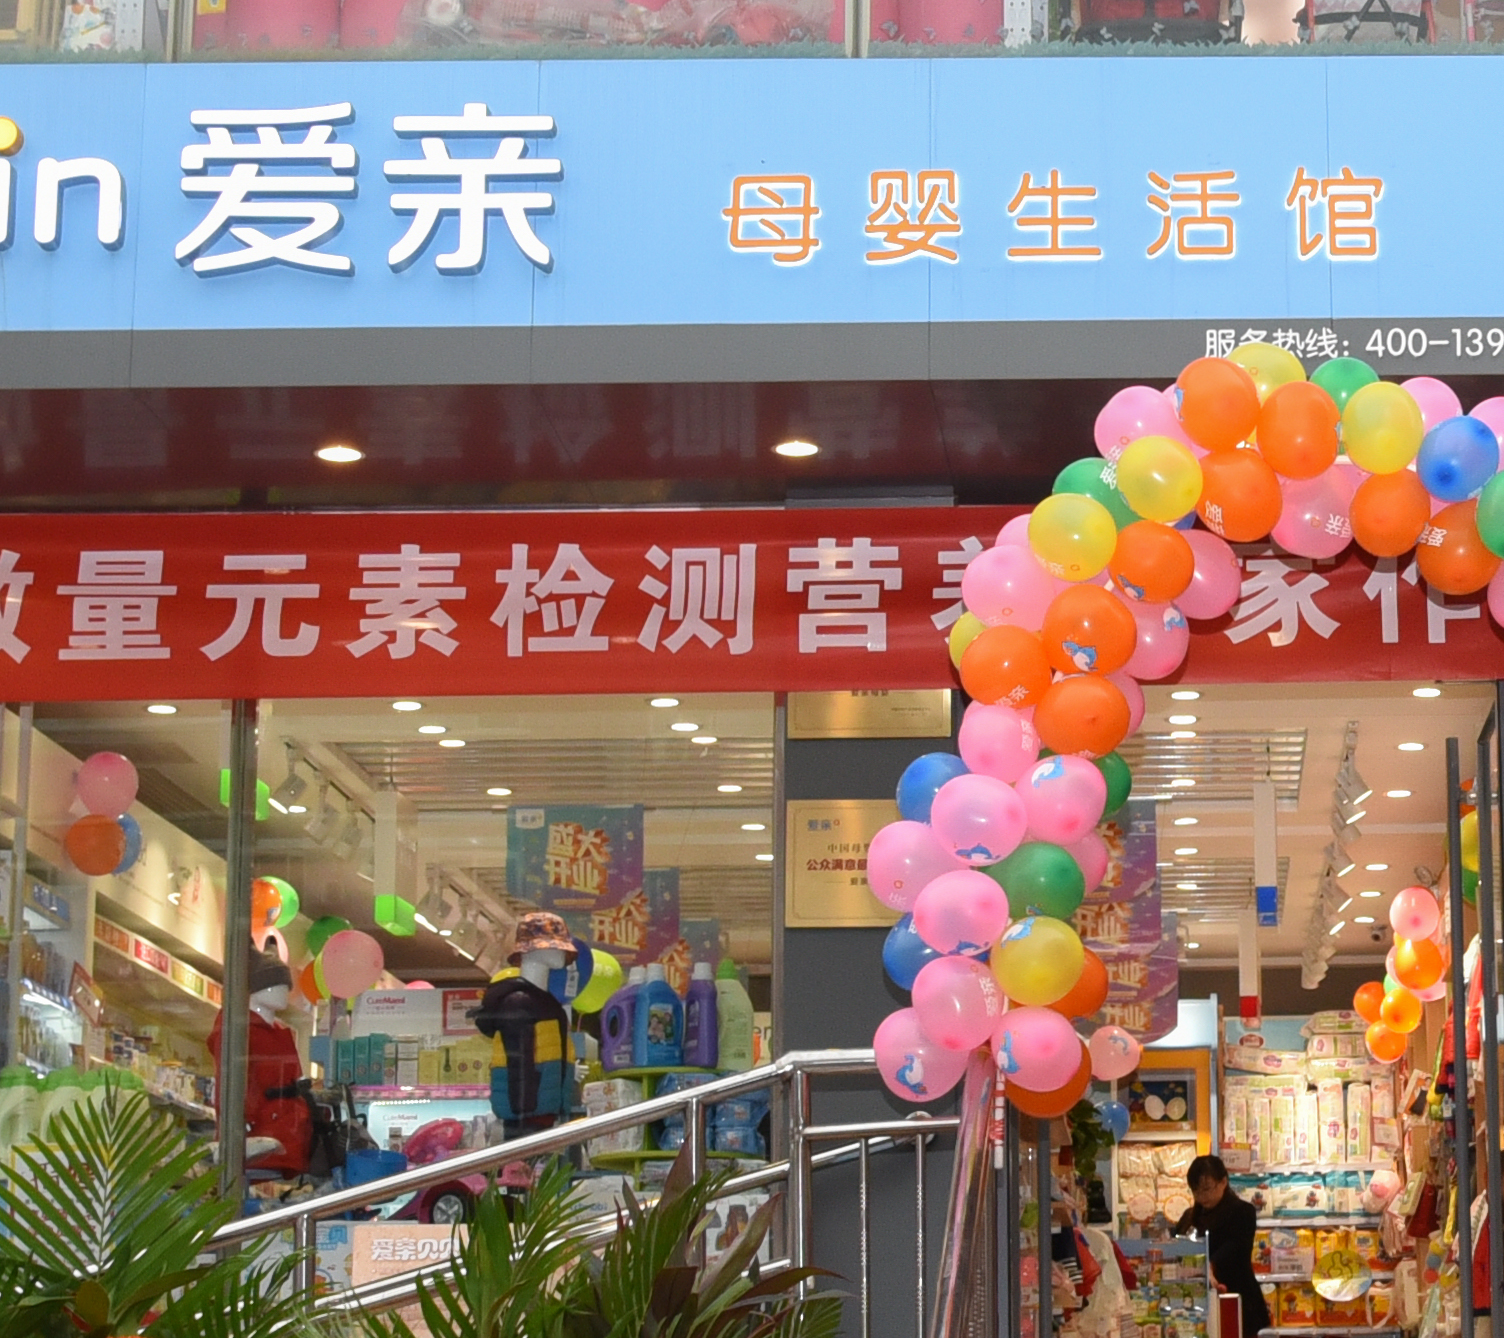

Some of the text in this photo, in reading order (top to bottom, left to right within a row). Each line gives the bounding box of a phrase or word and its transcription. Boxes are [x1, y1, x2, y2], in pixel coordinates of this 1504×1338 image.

[175, 101, 566, 281] 爱亲
[722, 169, 1390, 269] 母婴生活馆
